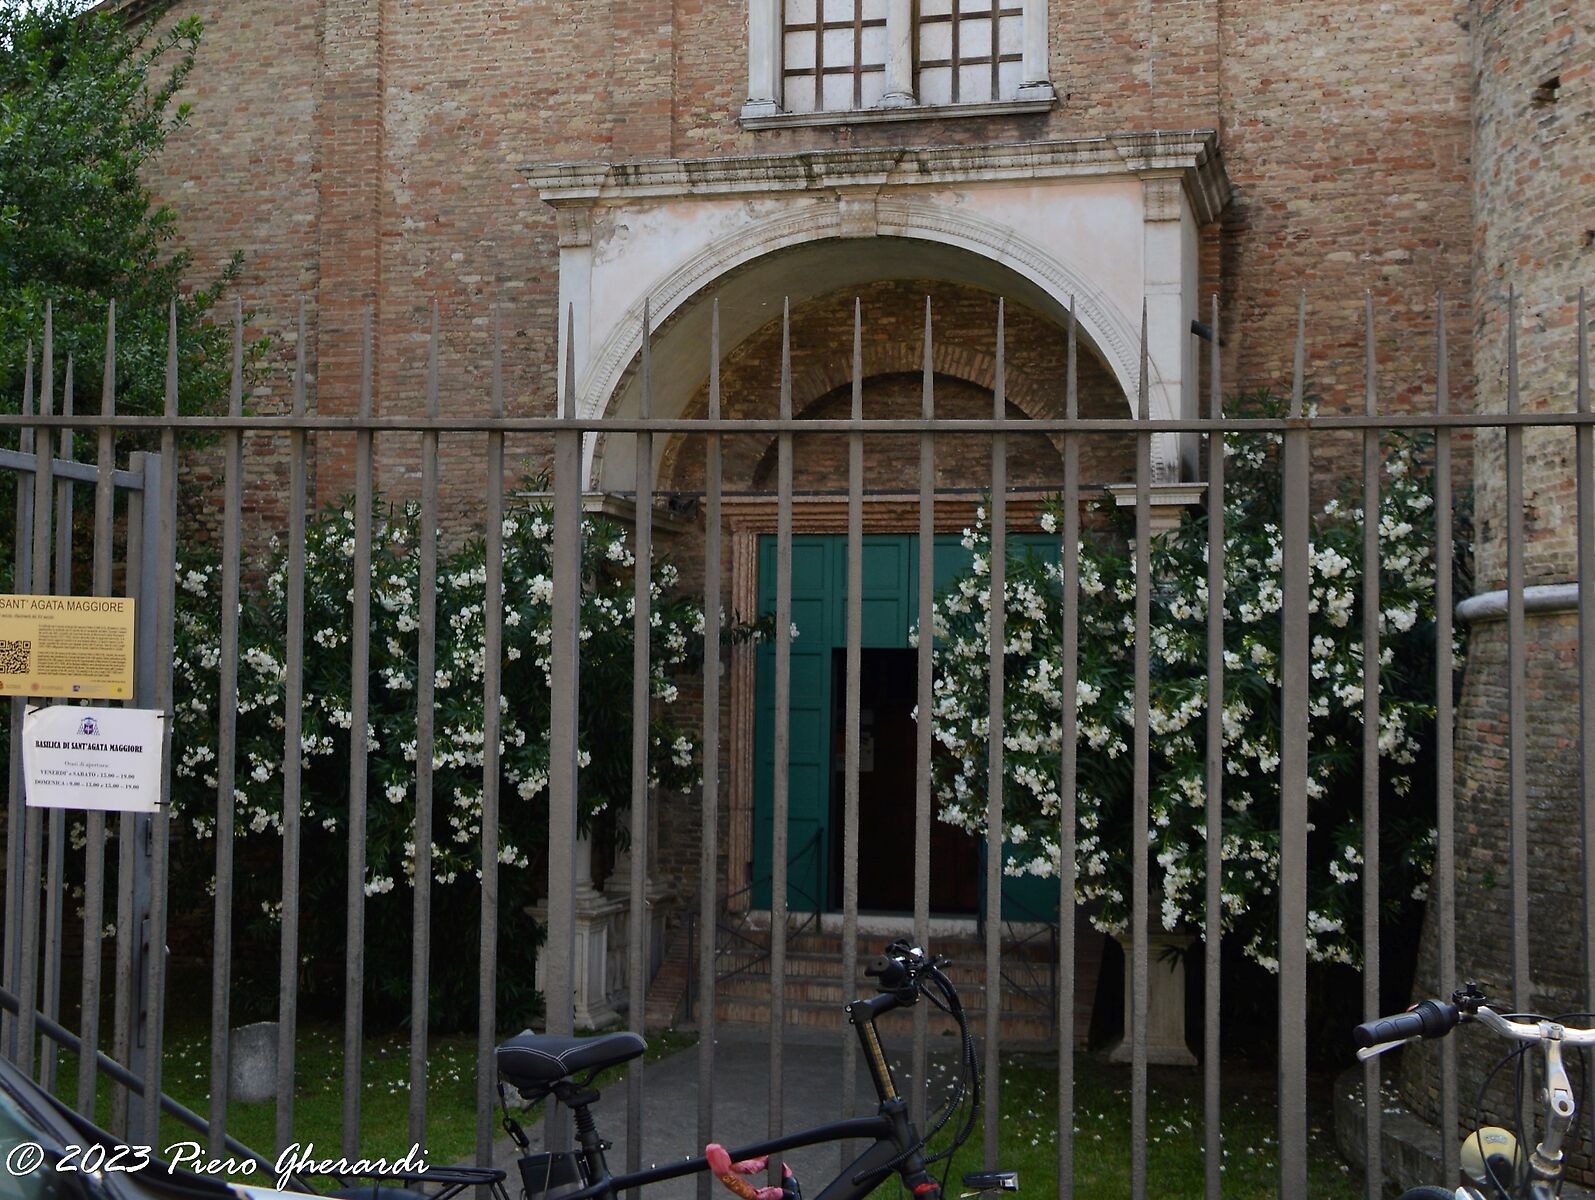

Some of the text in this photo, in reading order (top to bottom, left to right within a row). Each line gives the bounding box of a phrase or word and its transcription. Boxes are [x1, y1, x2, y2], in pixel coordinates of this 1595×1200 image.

[31, 599, 65, 610] AGATA
[66, 600, 124, 612] MAGGIORE
[35, 740, 143, 753] BASILICA DI SANT'AGATA MAGGIORE
